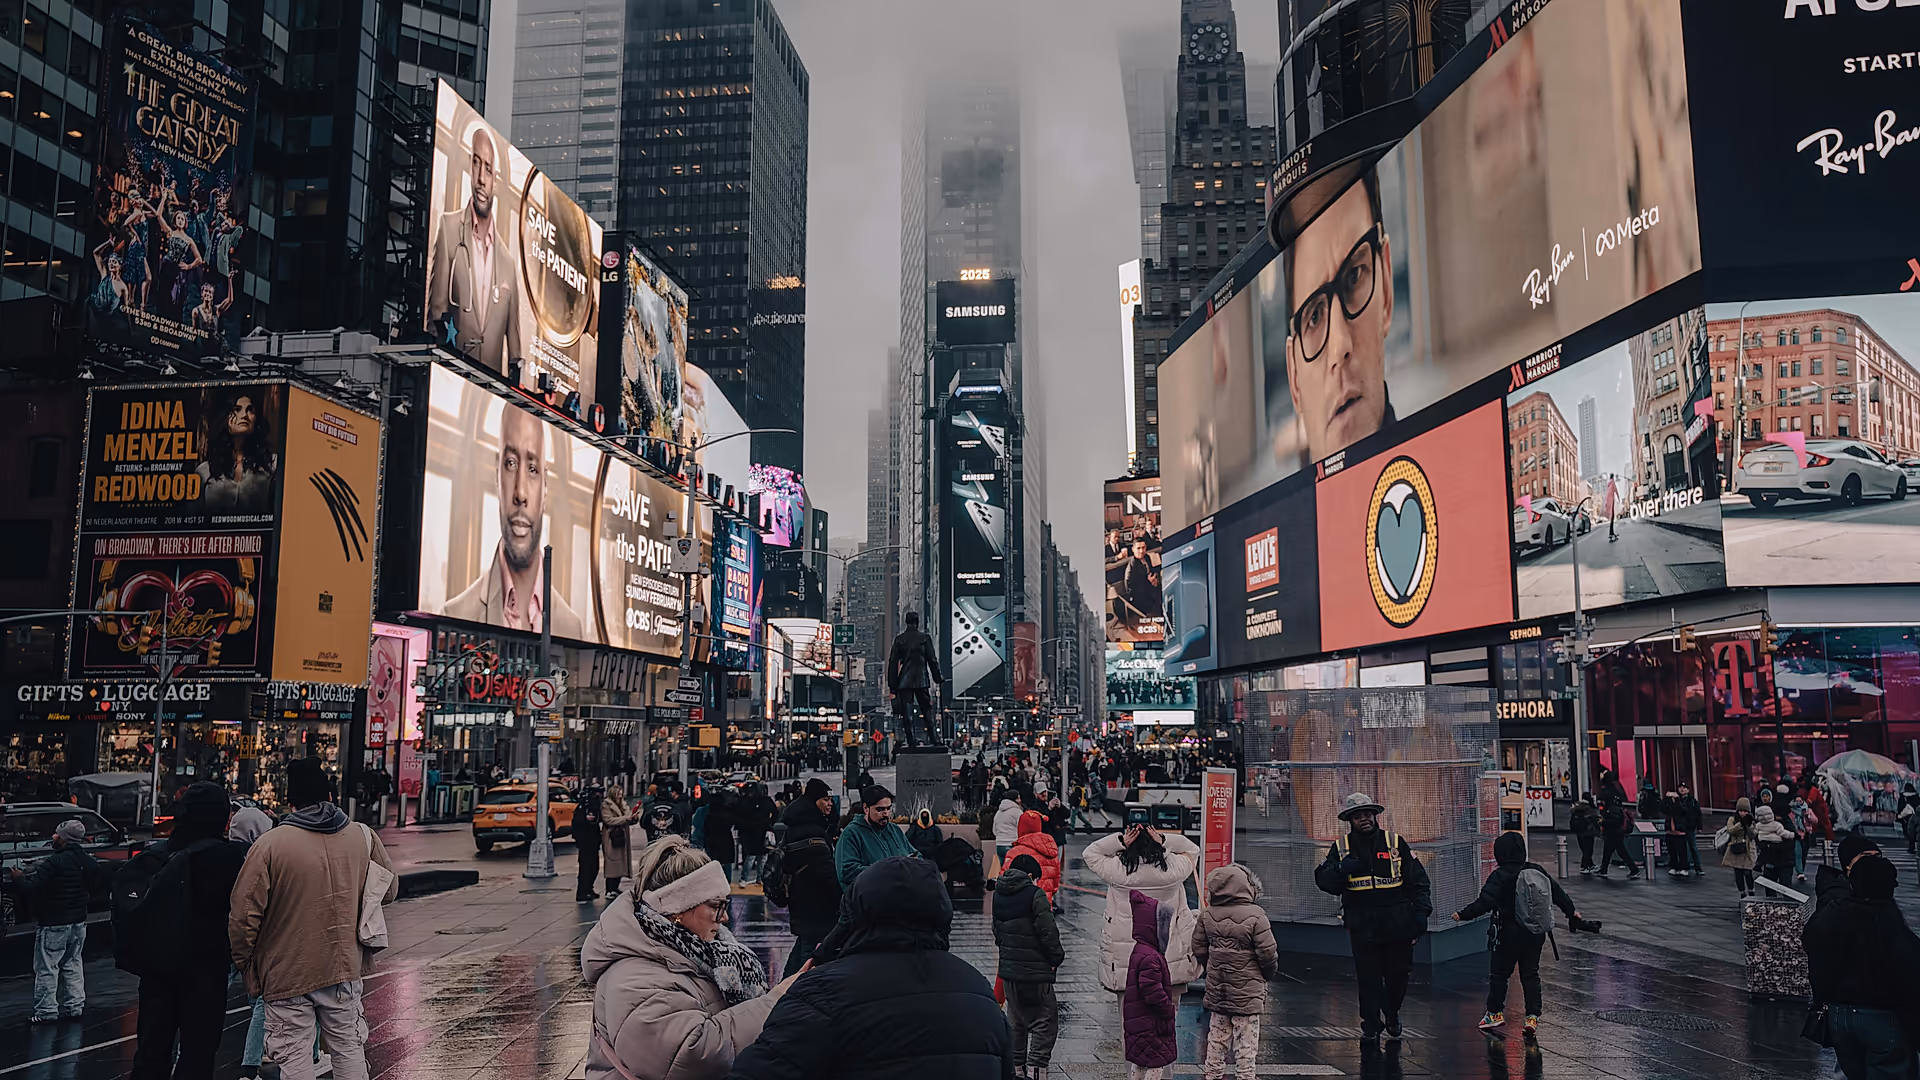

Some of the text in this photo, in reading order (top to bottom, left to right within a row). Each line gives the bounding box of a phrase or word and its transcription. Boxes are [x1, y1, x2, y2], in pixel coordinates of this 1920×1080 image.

[124, 48, 142, 61] THAT
[143, 58, 177, 78] EXPLODES
[138, 32, 174, 58] GREAT,
[176, 51, 194, 67] BIG
[196, 62, 248, 95] BROADWAY
[150, 50, 227, 96] EXTRAVAGANZA
[126, 70, 166, 111] THE
[170, 92, 243, 146] GREAT
[136, 106, 228, 164] GATSBY
[150, 140, 212, 173] A NEW MUSICAL
[1272, 143, 1312, 184] MARRIOTT
[1273, 160, 1308, 198] MARQUIS
[528, 206, 556, 246] SAVE
[1617, 205, 1660, 246] Meta
[532, 240, 588, 295] the PATIENT
[602, 271, 618, 282] LG
[960, 268, 990, 281] 2025
[1120, 284, 1140, 306] 03
[945, 304, 1006, 318] SAMSUNG
[141, 312, 180, 329] BROADWAY
[180, 323, 210, 339] THEATRE
[160, 324, 196, 342] BROADWAY
[1526, 344, 1562, 369] MARRIOTT
[1526, 358, 1559, 380] MARQUIS
[120, 400, 186, 430] IDINA
[103, 432, 198, 462] MENZEL
[115, 464, 142, 472] RETURNS
[150, 464, 183, 472] BROADWAY
[962, 474, 994, 482] SAMSUNG
[94, 474, 202, 502] REDWOOD
[612, 483, 650, 528] SAVE
[1630, 485, 1704, 521] over there
[94, 518, 132, 526] NEDERLANDER
[134, 516, 158, 524] THEATRE
[184, 516, 196, 524] 41ST
[197, 516, 204, 524] ST
[212, 514, 274, 524] REDWOODMUSICAL.COM
[94, 535, 262, 556] ON BROADWAY, THERE'S LIFE AFTER ROMEO
[616, 533, 635, 564] the
[1247, 534, 1276, 572] LEVI'S
[631, 574, 642, 584] NEW
[728, 566, 749, 587] RADIO
[626, 584, 650, 602] SUNDAY
[650, 591, 678, 611] FEBRUARY
[727, 583, 749, 602] CITY
[634, 611, 650, 632] CBS
[726, 604, 739, 618] MUSIC
[1251, 609, 1277, 625] COMPLETE
[1143, 626, 1157, 634] CBS
[1246, 619, 1282, 640] UNKNOWN
[1510, 626, 1542, 641] SEPHORA
[17, 684, 84, 701] GIFTS
[267, 682, 356, 702] GIFTS LUGGAGE
[95, 702, 131, 712] I NY
[116, 712, 146, 720] SONY
[302, 701, 322, 710] I NY
[320, 712, 338, 720] SONY
[1496, 700, 1554, 719] SEPHORA
[1208, 786, 1232, 798] LOVE EVER
[1212, 798, 1227, 809] AFTER
